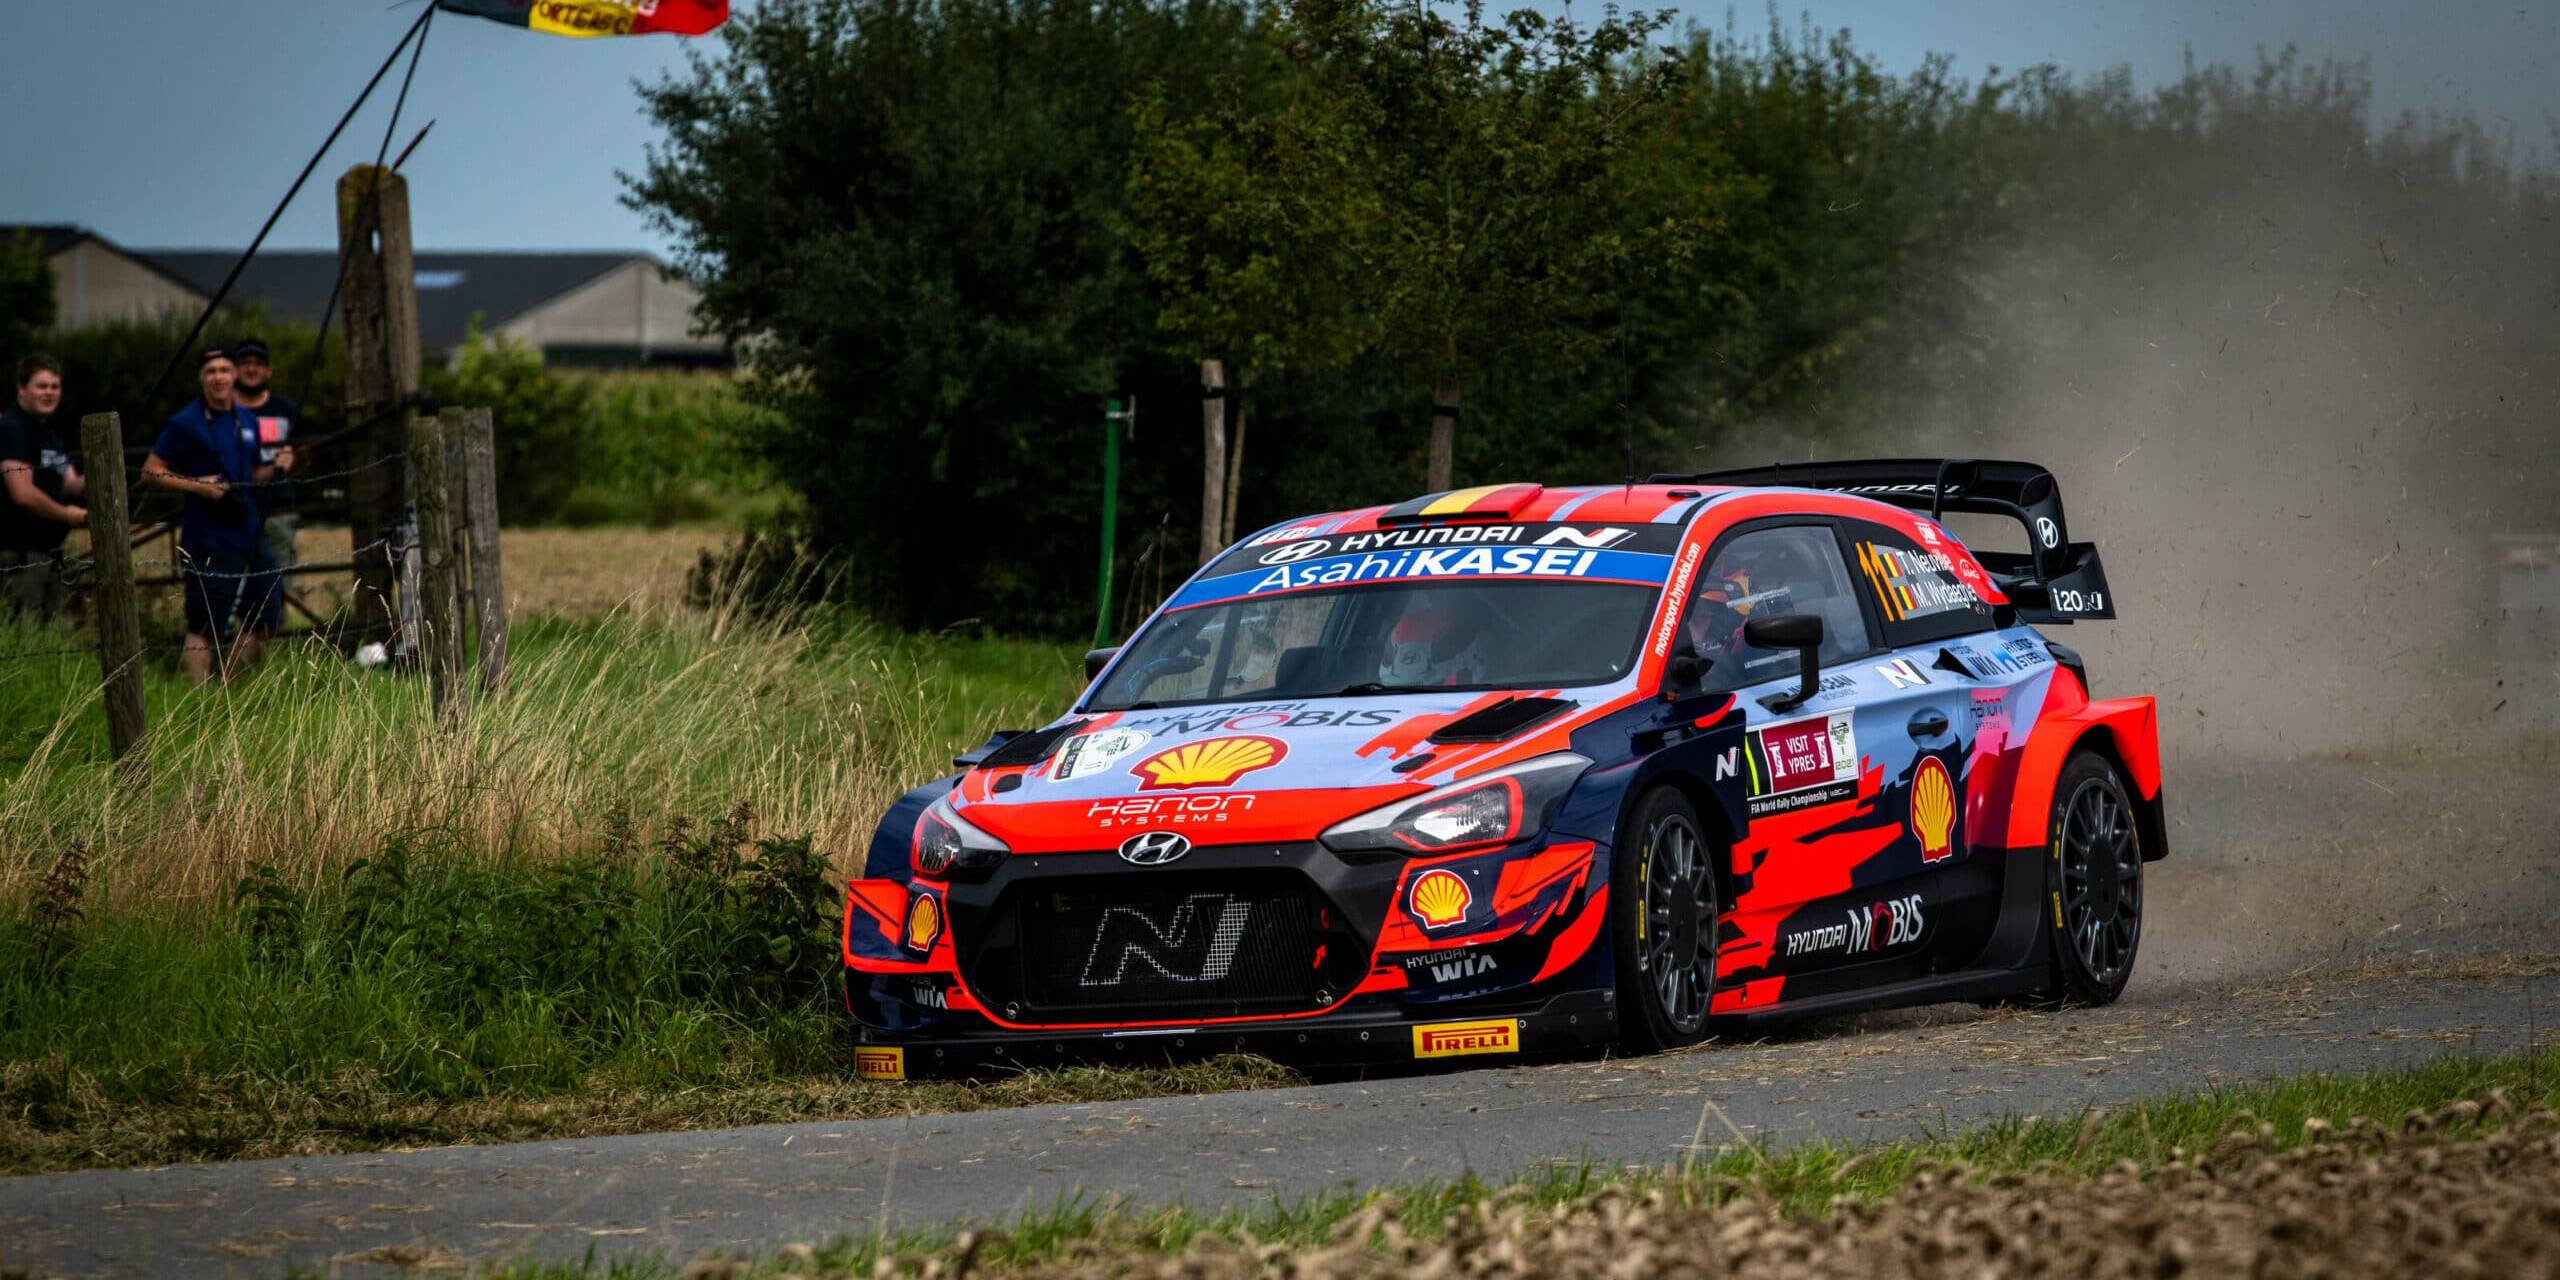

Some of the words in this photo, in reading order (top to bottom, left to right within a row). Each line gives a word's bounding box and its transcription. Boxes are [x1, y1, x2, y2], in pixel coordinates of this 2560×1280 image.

[1340, 526, 1525, 551] HYUNDAI
[1248, 548, 1598, 594] AsahiKASEI
[1896, 551, 1915, 576] T.
[1907, 549, 1955, 573] Neuville
[1856, 541, 1906, 622] 11
[1654, 542, 1701, 658] motorsport.hyundai.com
[1911, 582, 1932, 608] M.
[2052, 587, 2083, 612] i20
[1127, 703, 1307, 727] HYUNDAI
[1152, 709, 1401, 737] MOBIS
[1785, 735, 1809, 755] VISIT
[1787, 754, 1817, 775] YPRES
[1100, 812, 1228, 828] SYSTEMS
[1750, 803, 1761, 814] FIA
[1786, 923, 1848, 957] HYUNDAI
[1846, 894, 1924, 956] MOBIS
[1406, 948, 1467, 969] HYUNDAI
[1422, 1026, 1510, 1053] PIRELLI
